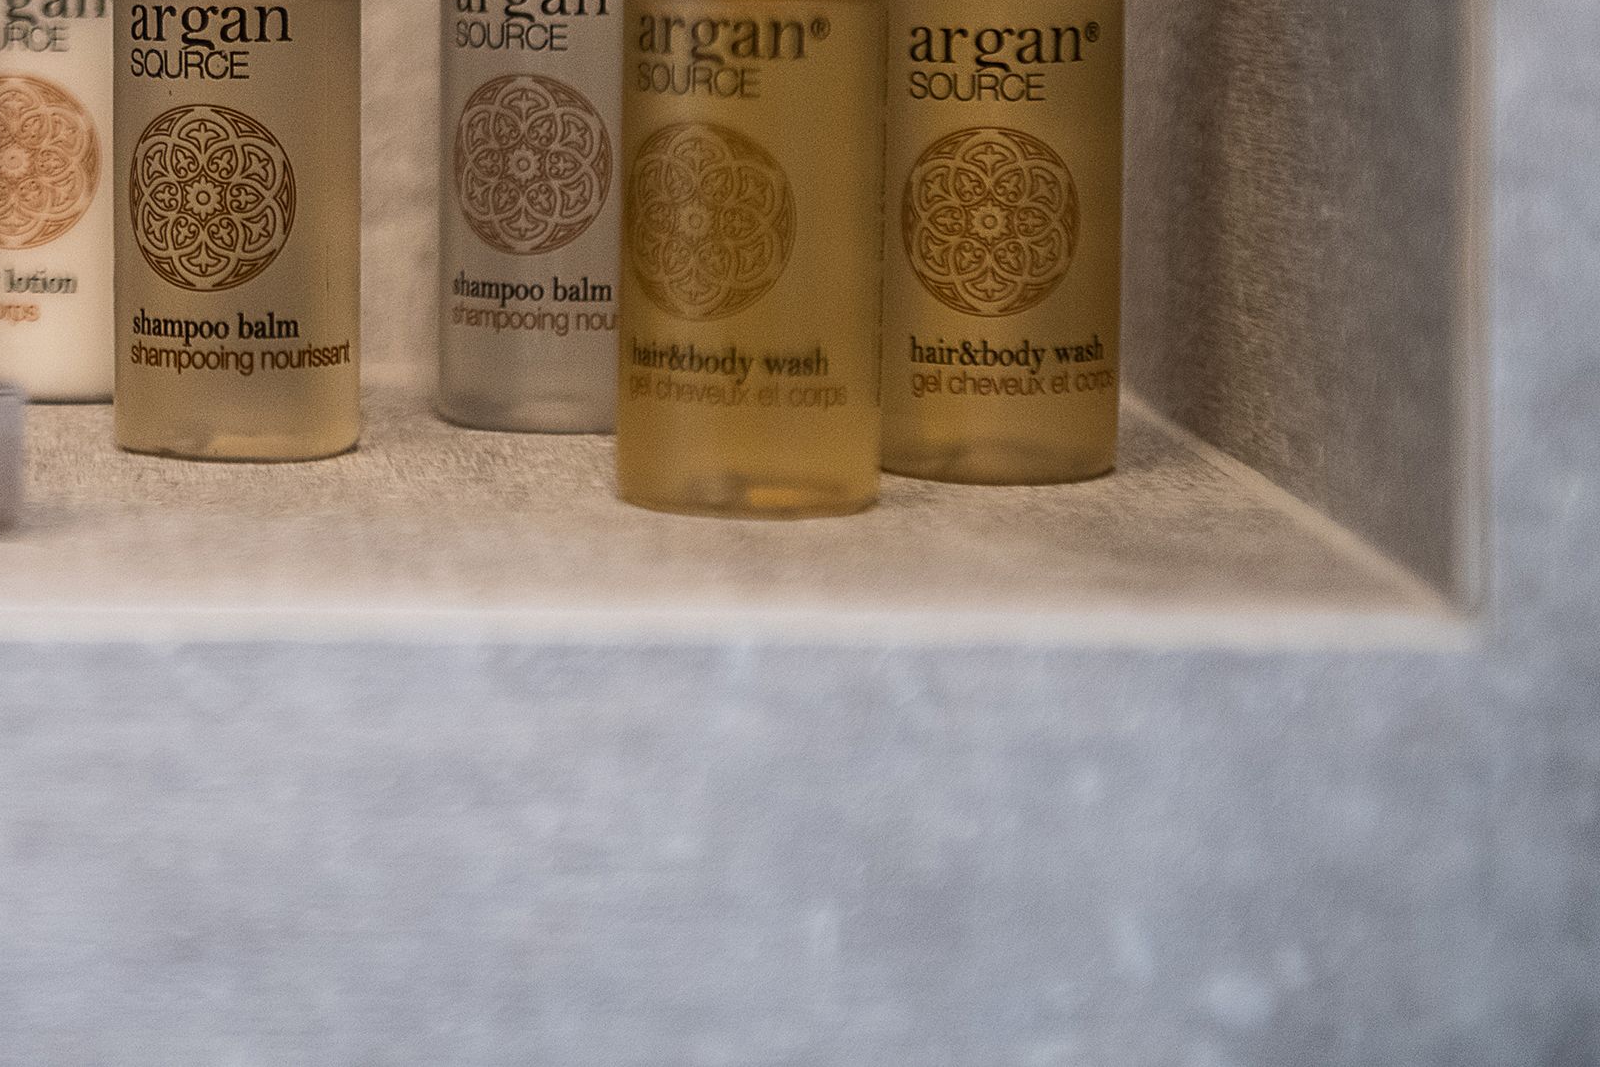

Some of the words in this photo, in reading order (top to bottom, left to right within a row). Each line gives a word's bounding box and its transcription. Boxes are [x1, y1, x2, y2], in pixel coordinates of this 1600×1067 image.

[130, 4, 293, 50] argan
[456, 20, 568, 51] SOURCE
[130, 48, 250, 80] SOURCE
[637, 62, 761, 98] SOURCE
[910, 71, 1046, 102] SOURCE
[4, 268, 78, 294] lotion
[453, 271, 545, 308] shampoo
[553, 276, 612, 302] balm
[132, 309, 229, 347] shampoo
[238, 312, 300, 339] balm
[452, 302, 569, 337] shampooing
[575, 311, 618, 332] nou
[130, 339, 254, 376] shampooing
[260, 340, 350, 370] nourissant
[631, 337, 754, 385] hair&body
[763, 346, 829, 376] wash
[910, 336, 1047, 376] hair&body
[1053, 334, 1104, 364] wash
[912, 370, 942, 398] gel
[950, 370, 1047, 396] cheveux
[1051, 371, 1070, 395] et
